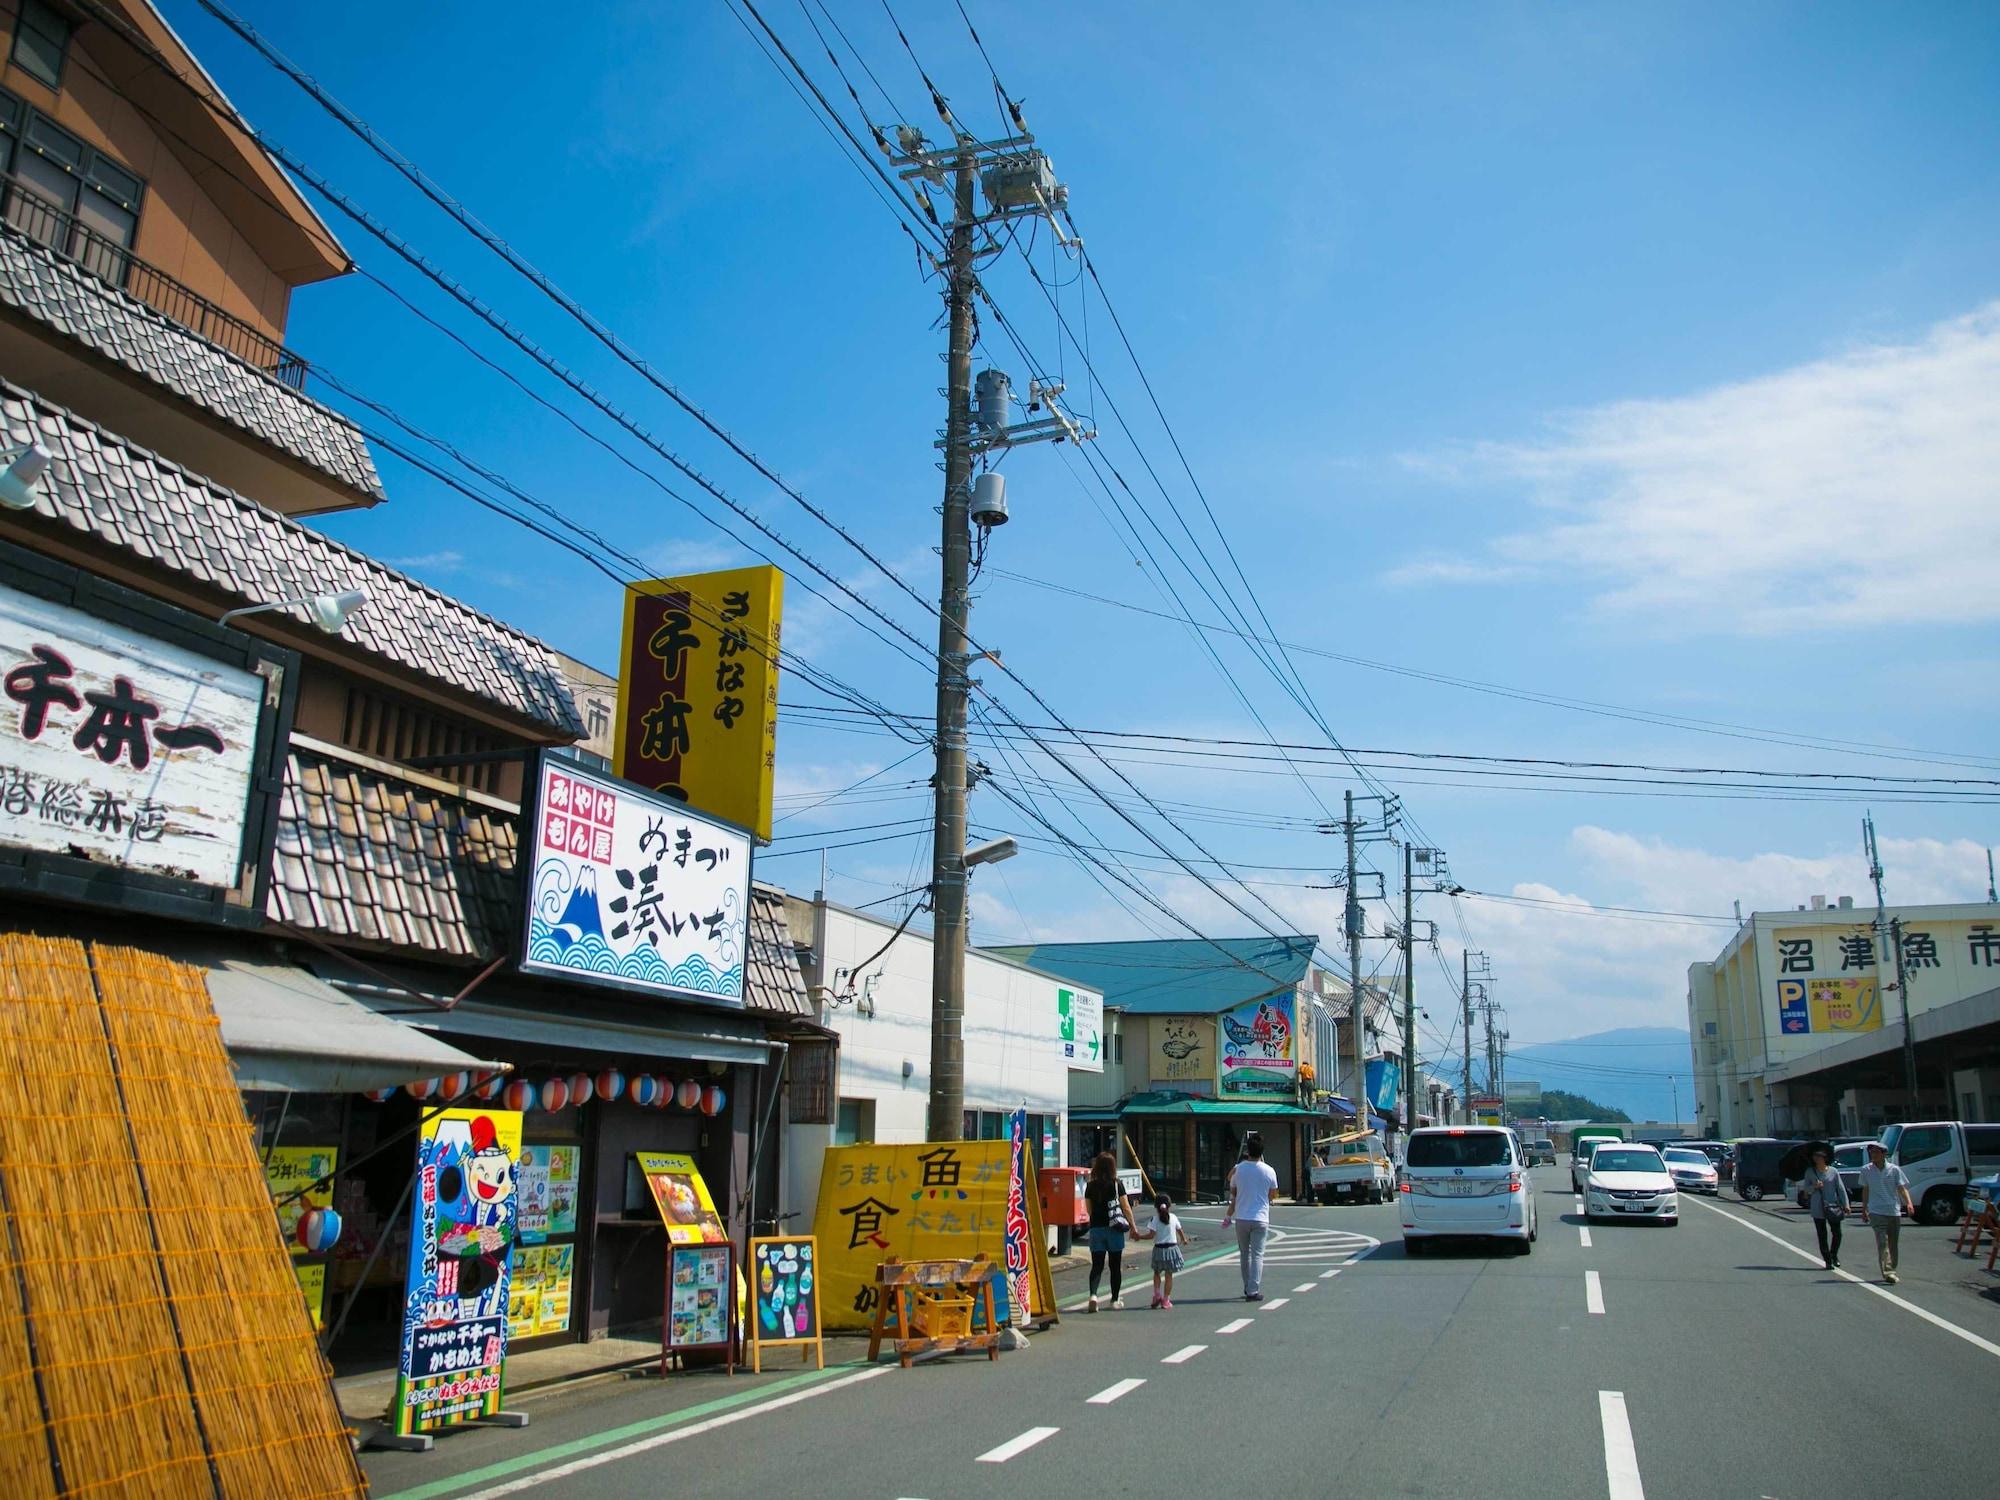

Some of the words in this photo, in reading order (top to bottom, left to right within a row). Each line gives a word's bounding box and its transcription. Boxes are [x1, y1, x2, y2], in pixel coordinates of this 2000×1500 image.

[4, 643, 225, 771] 千本一
[639, 815, 730, 872] ぬまづ
[609, 862, 726, 948] 湊いち
[1780, 982, 1804, 1009] P
